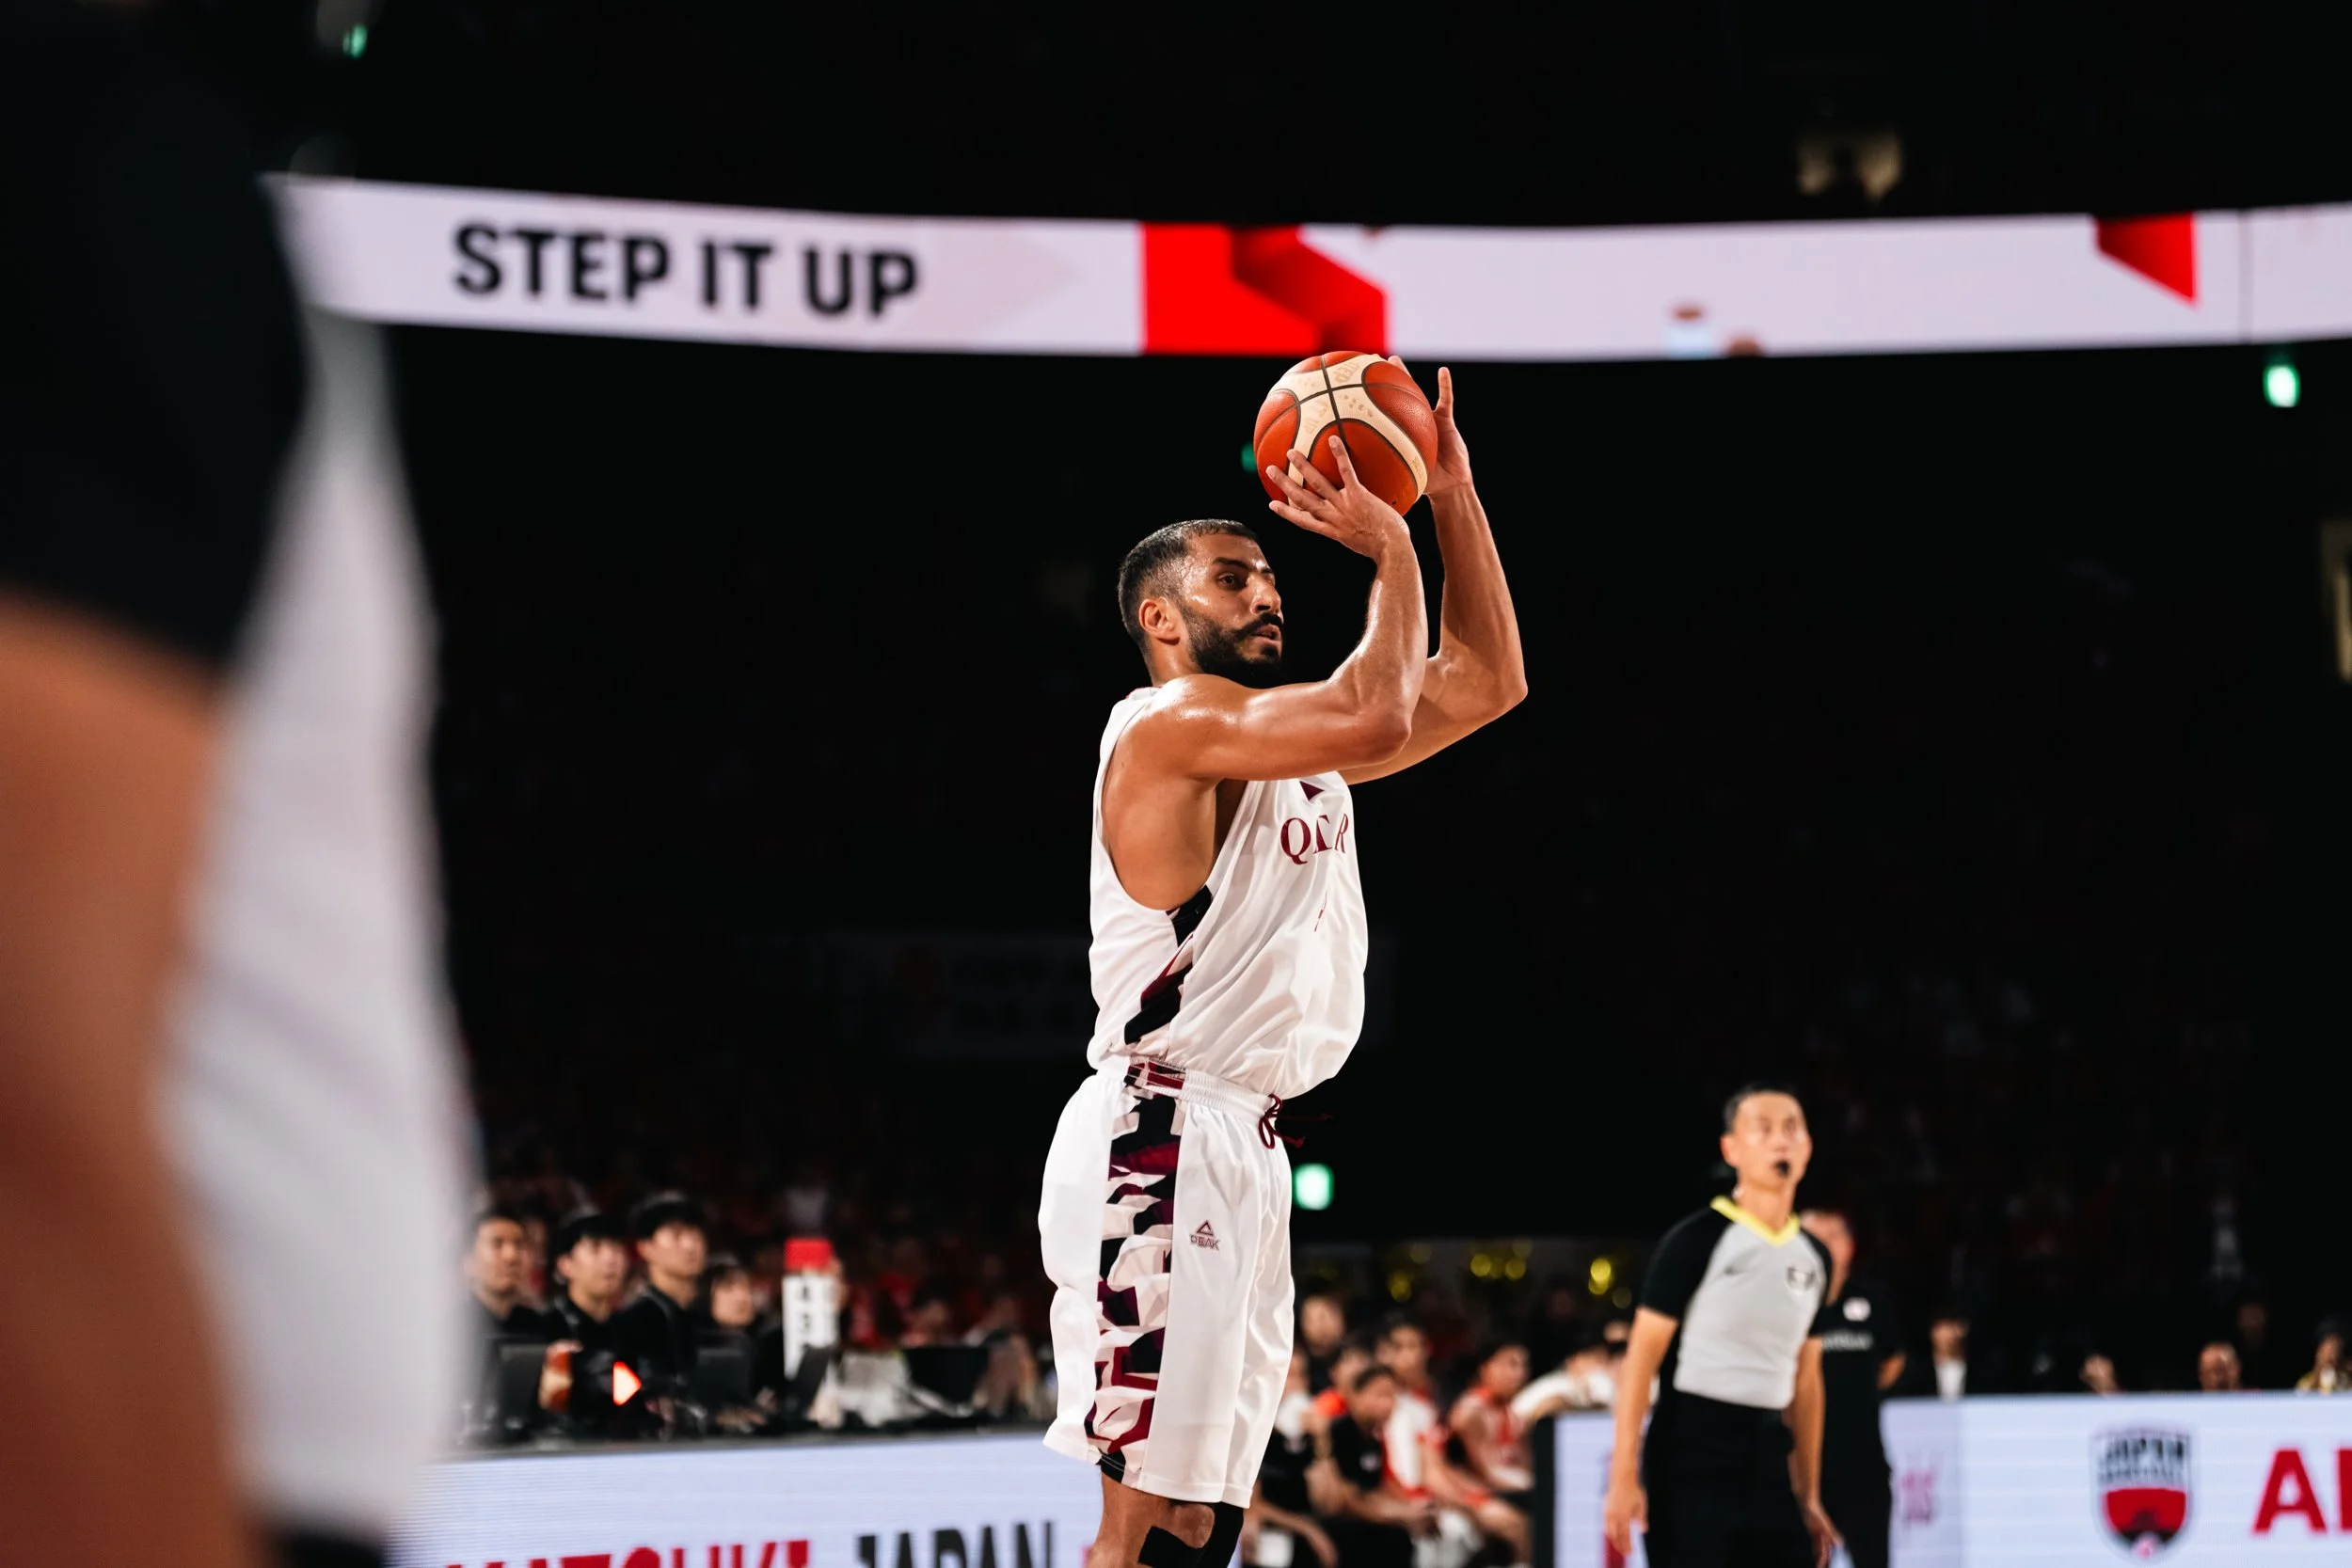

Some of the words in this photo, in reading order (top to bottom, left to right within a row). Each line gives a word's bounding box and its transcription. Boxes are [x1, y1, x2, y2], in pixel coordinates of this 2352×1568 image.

[453, 221, 672, 304] STEP
[699, 237, 775, 312] IT
[802, 244, 920, 319] UP
